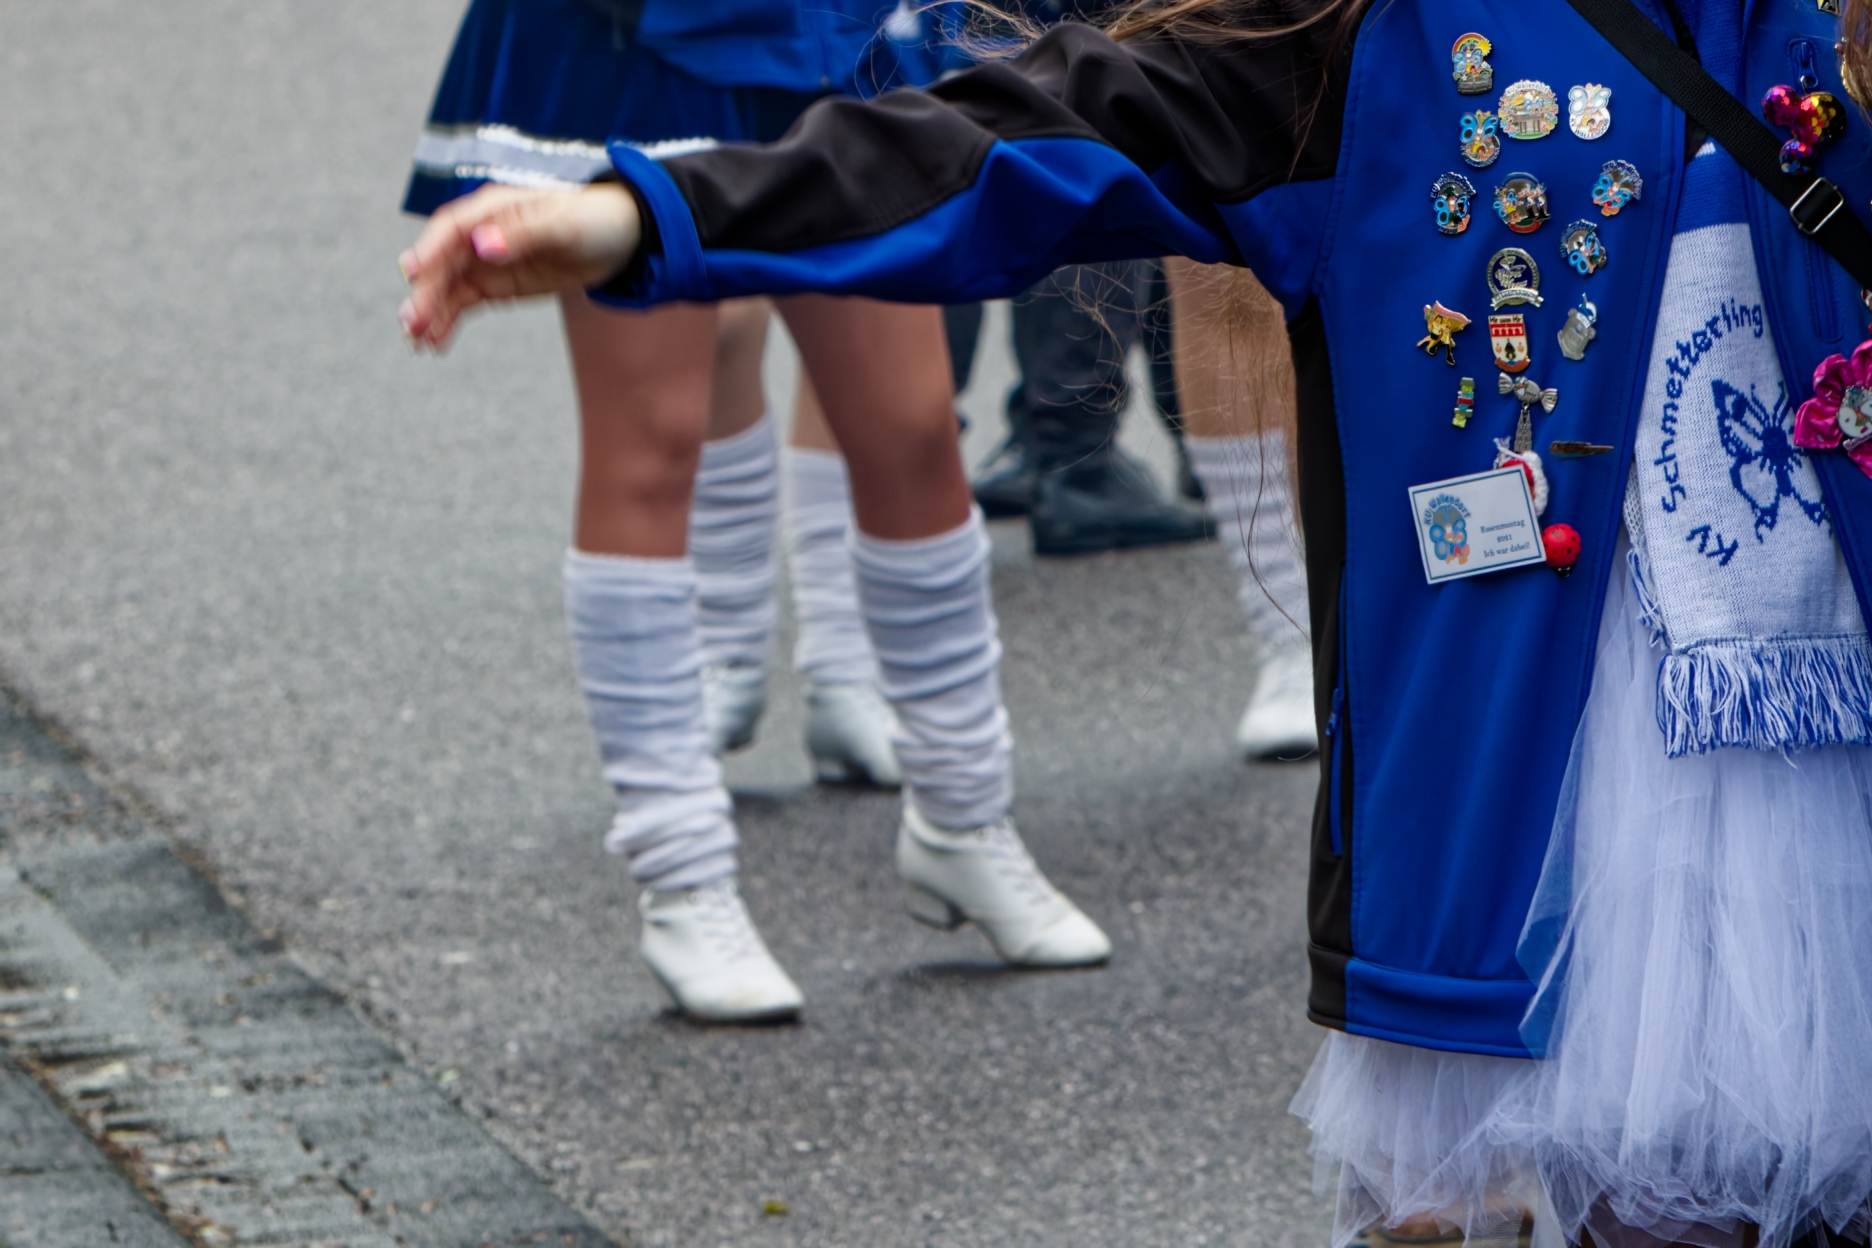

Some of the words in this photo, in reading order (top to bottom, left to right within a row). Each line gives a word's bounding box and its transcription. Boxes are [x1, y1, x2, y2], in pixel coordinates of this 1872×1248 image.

[1654, 298, 1763, 513] Schmetterling
[1480, 519, 1526, 533] Rosenmontag
[1483, 549, 1495, 558] Ich
